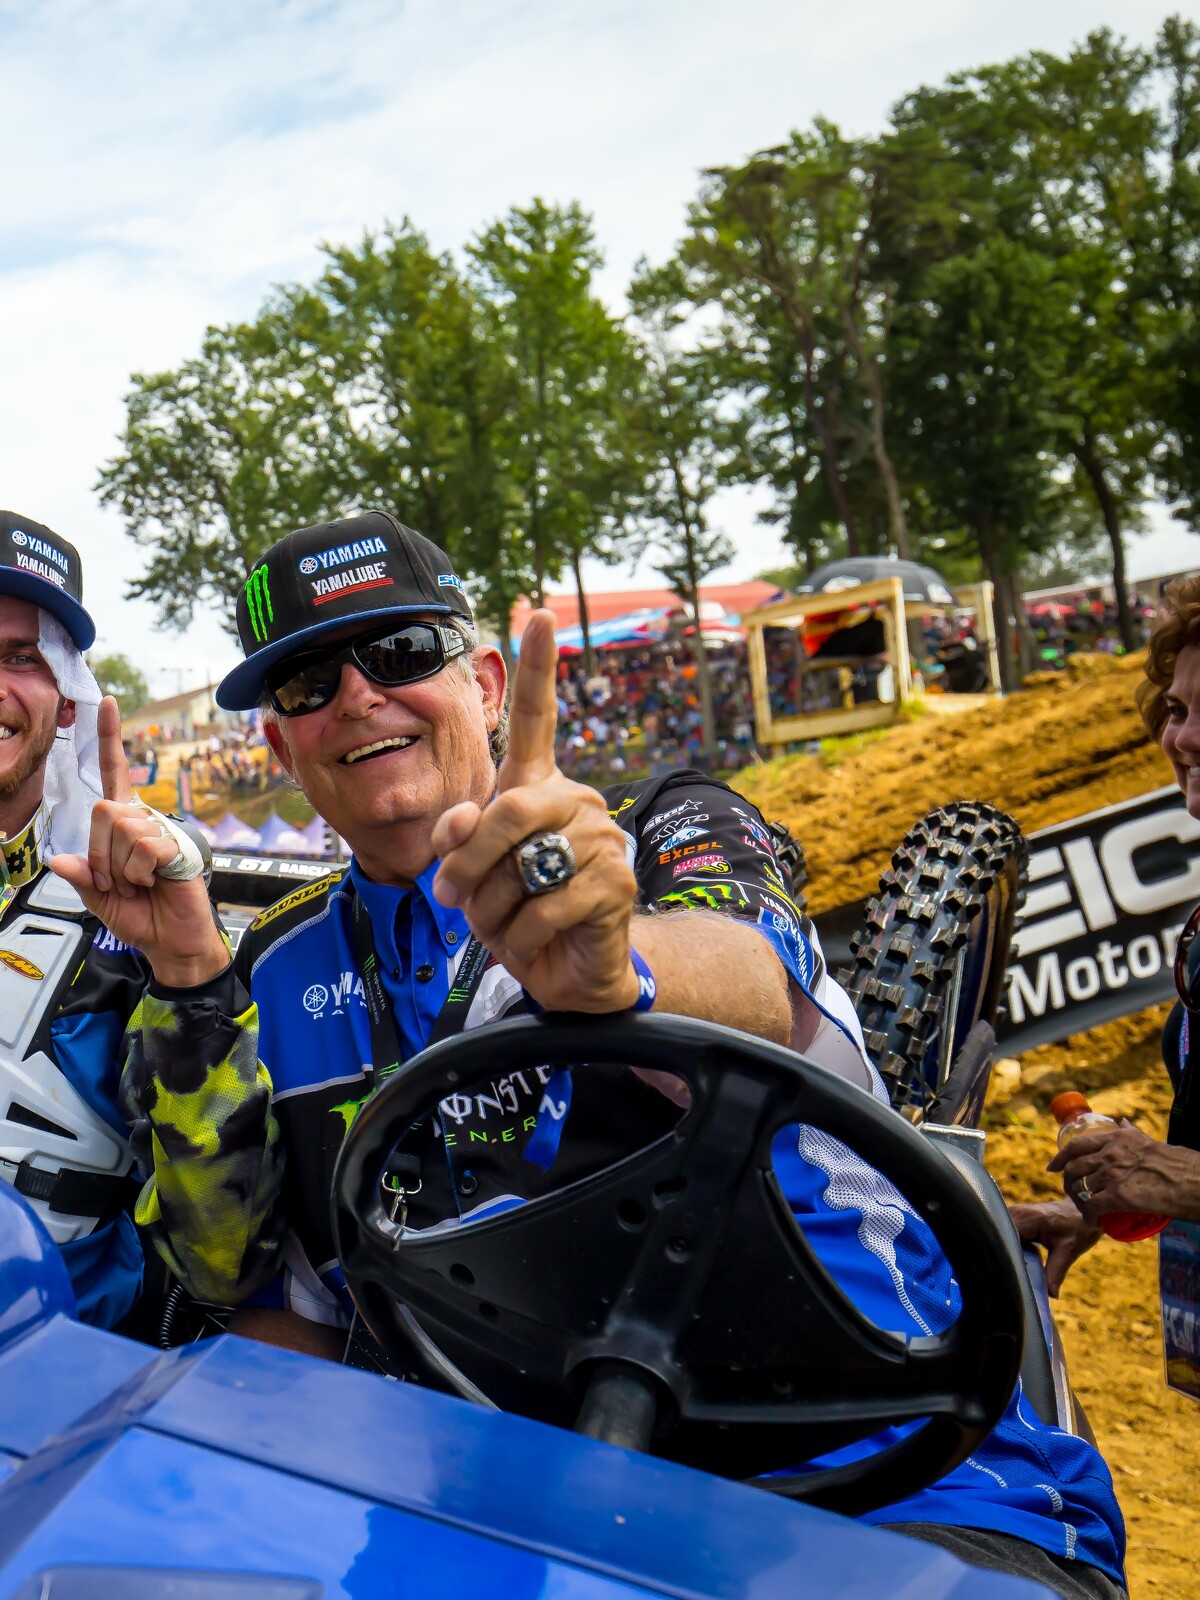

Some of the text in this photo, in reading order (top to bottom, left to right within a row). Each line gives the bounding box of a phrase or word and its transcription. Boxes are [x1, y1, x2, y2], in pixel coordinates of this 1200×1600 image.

[27, 535, 69, 575] YAMAHA
[318, 536, 387, 568] YAMAHA
[16, 551, 66, 590] YAMALUBE
[311, 562, 386, 596] YAMALUBE
[659, 841, 723, 865] EXCEL
[263, 879, 331, 921] DUNLO
